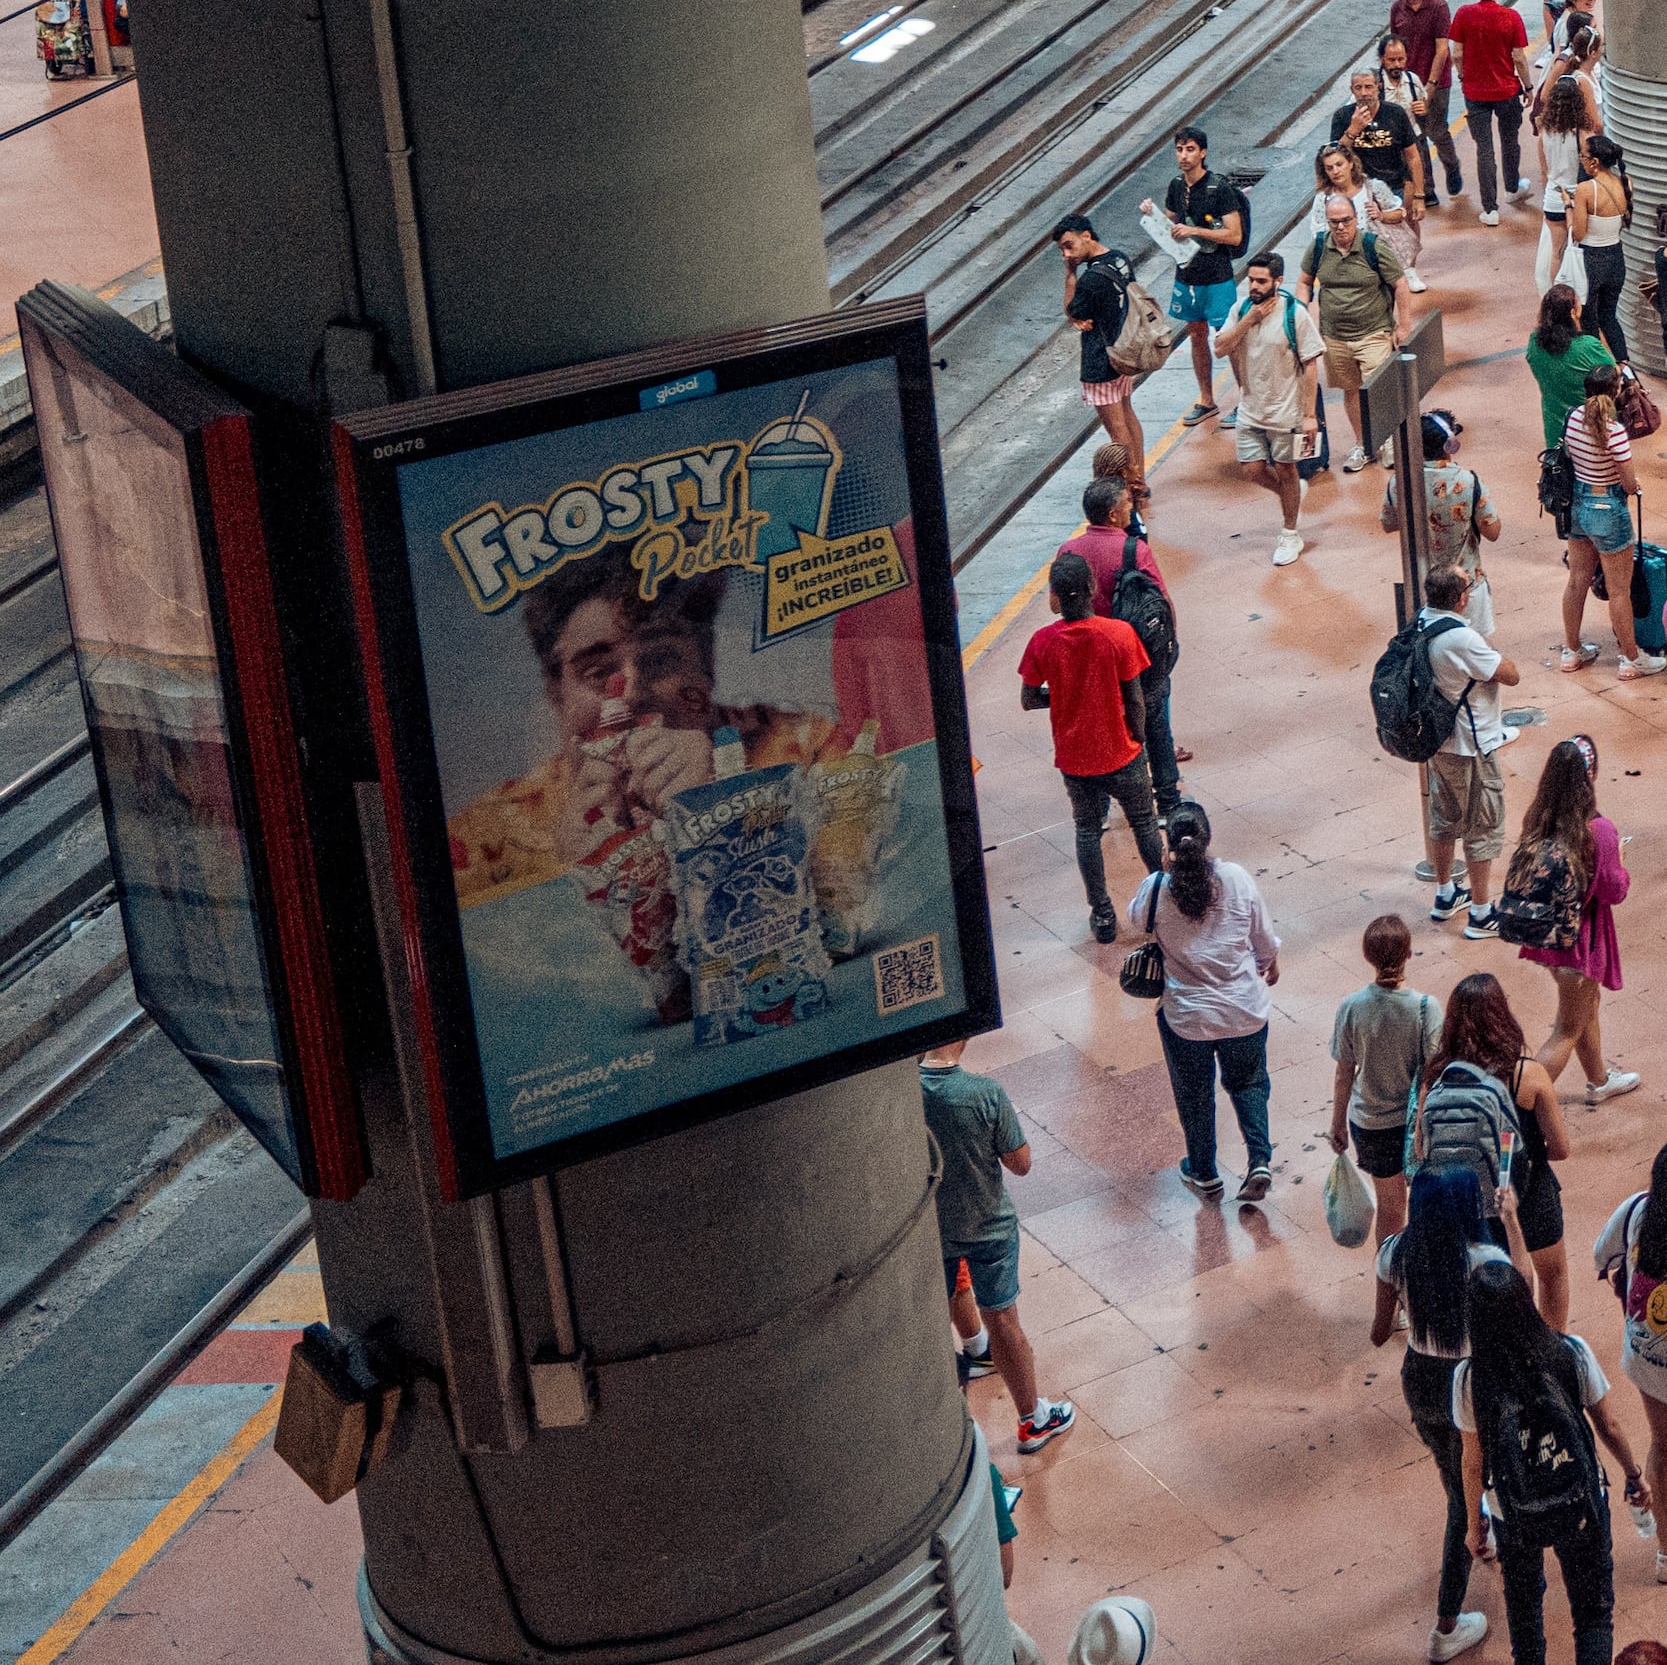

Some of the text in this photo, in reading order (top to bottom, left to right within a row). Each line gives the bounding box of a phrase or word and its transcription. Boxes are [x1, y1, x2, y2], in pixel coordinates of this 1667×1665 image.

[654, 376, 700, 405] global
[372, 437, 427, 460] 00478
[451, 445, 739, 599] FROSTY
[634, 510, 768, 593] Pocket
[774, 534, 886, 584] granizado
[793, 553, 889, 593] instantáneo
[775, 567, 894, 623] ¡INCREÍBLE!
[684, 783, 782, 843] FROSTY
[713, 914, 798, 955] GRANIZADO
